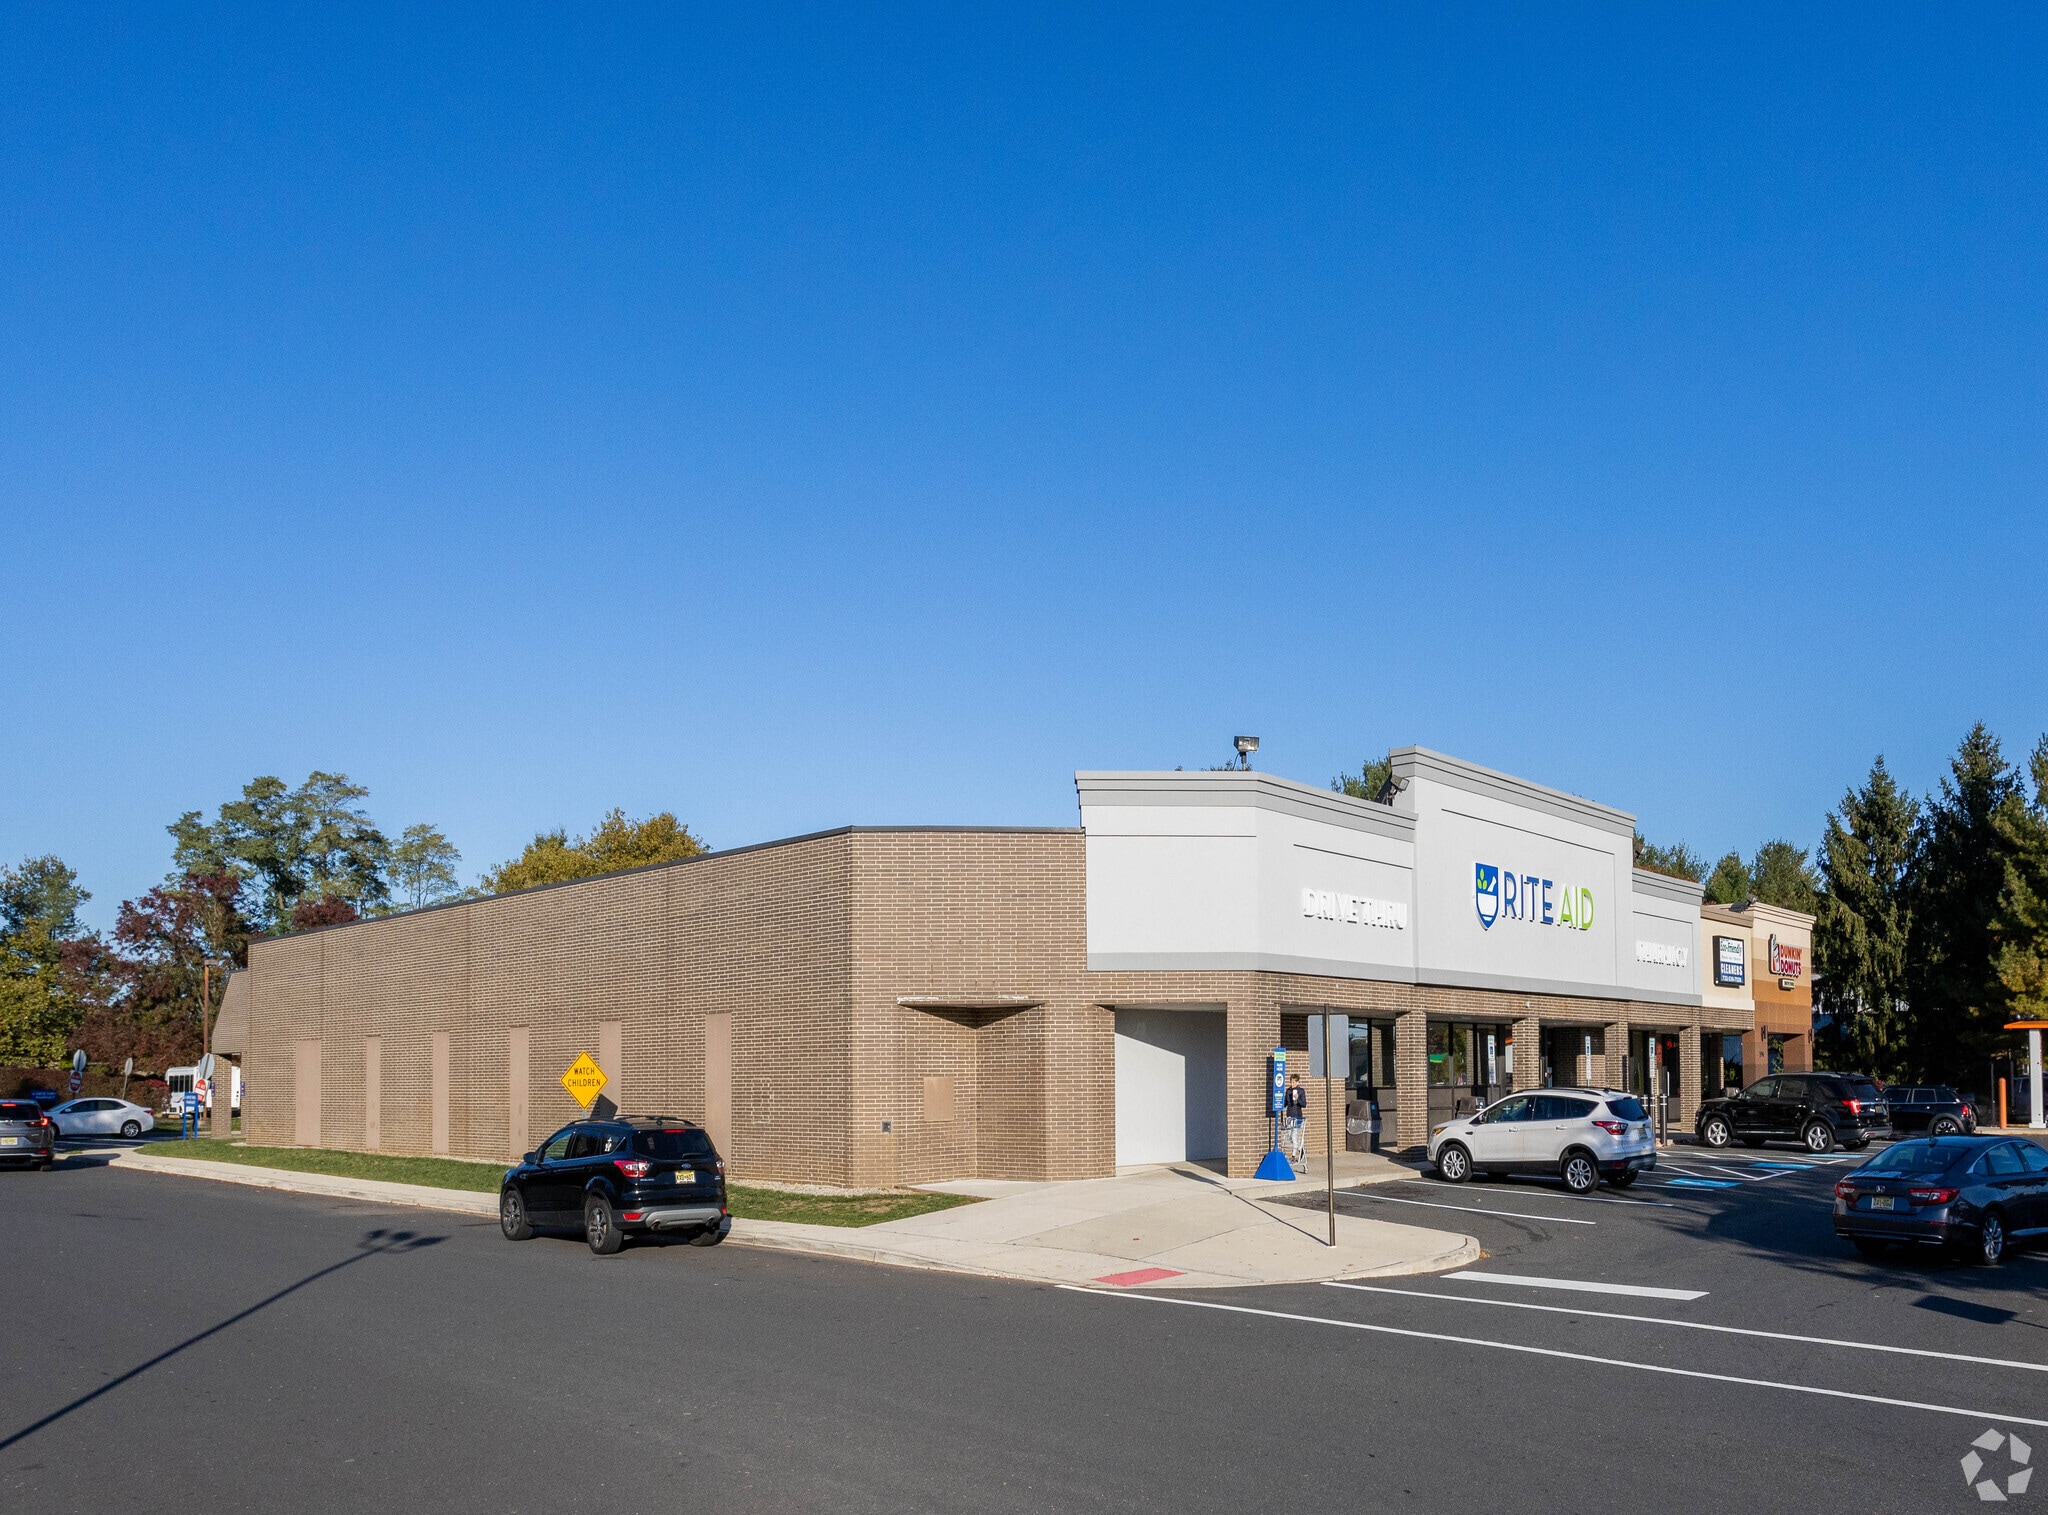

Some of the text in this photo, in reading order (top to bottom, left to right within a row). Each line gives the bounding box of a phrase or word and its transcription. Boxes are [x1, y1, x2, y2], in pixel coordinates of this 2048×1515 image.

[1502, 869, 1595, 931] RITE AID
[1302, 887, 1407, 931] DRIVE THRU
[1635, 940, 1690, 968] PHARMACY
[1780, 944, 1803, 961] DUNKIN'
[1720, 962, 1744, 976] CLEANERS
[1780, 959, 1802, 976] DONUTS
[573, 1067, 595, 1075] WATCH
[567, 1078, 601, 1087] CHILDREN
